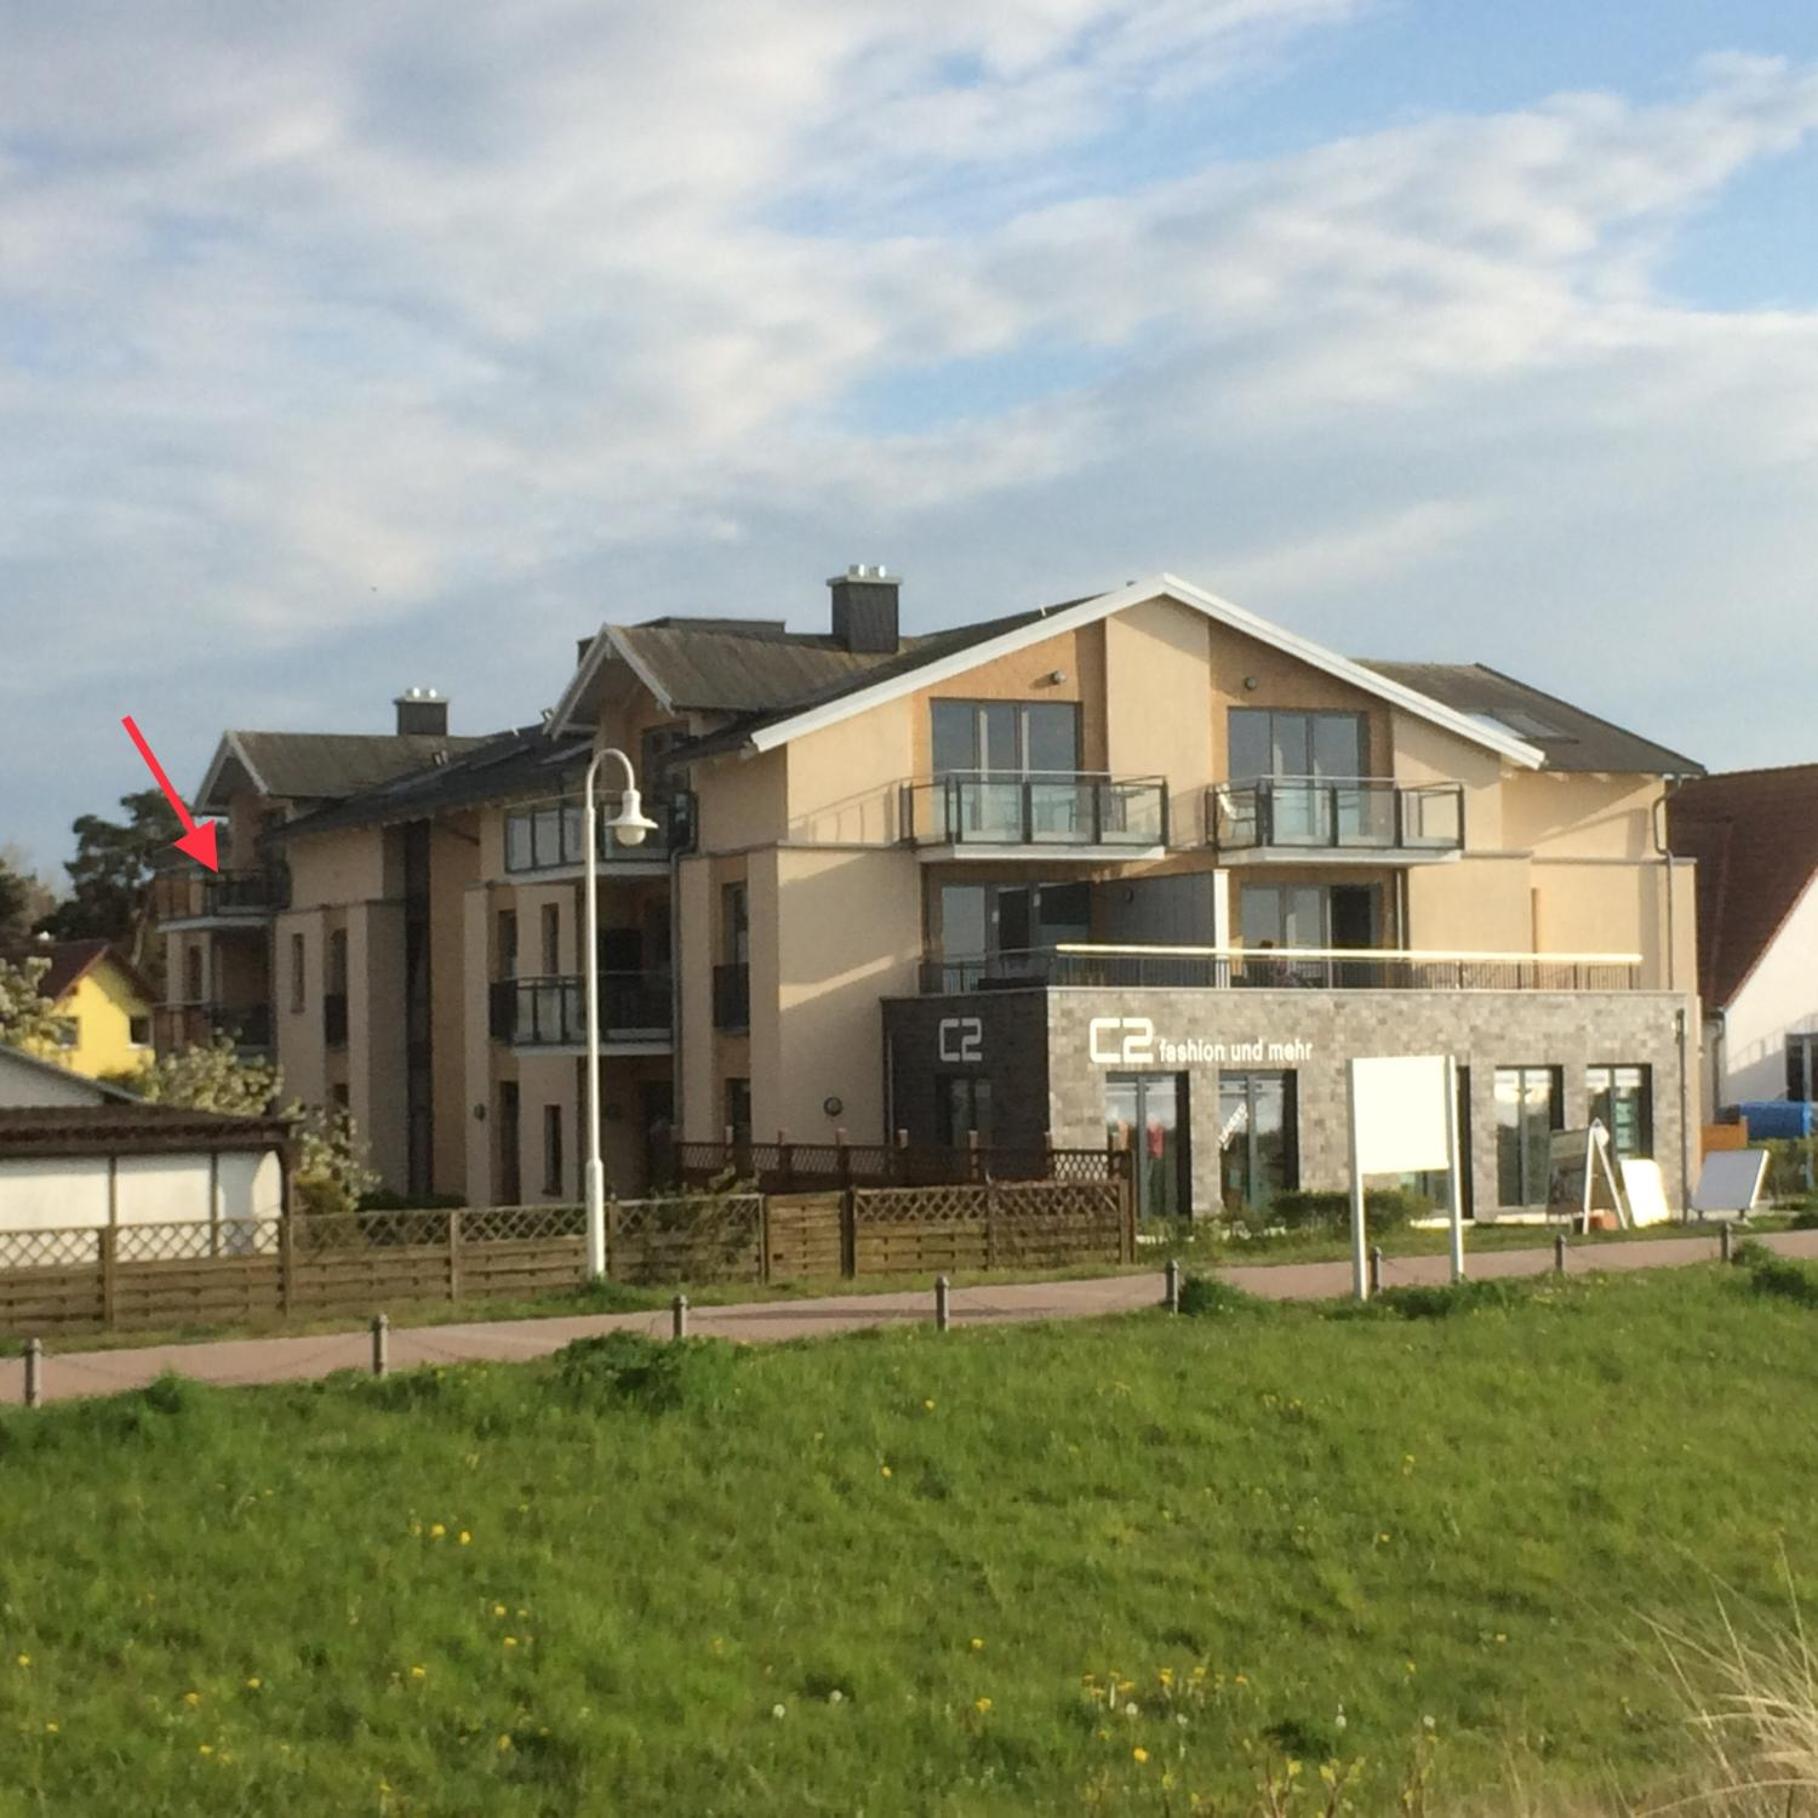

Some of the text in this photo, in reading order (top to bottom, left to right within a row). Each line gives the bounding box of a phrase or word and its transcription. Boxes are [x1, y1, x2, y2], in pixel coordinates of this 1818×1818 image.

[939, 1017, 982, 1062] C2
[1089, 1017, 1313, 1063] C2 fashion und mehr
